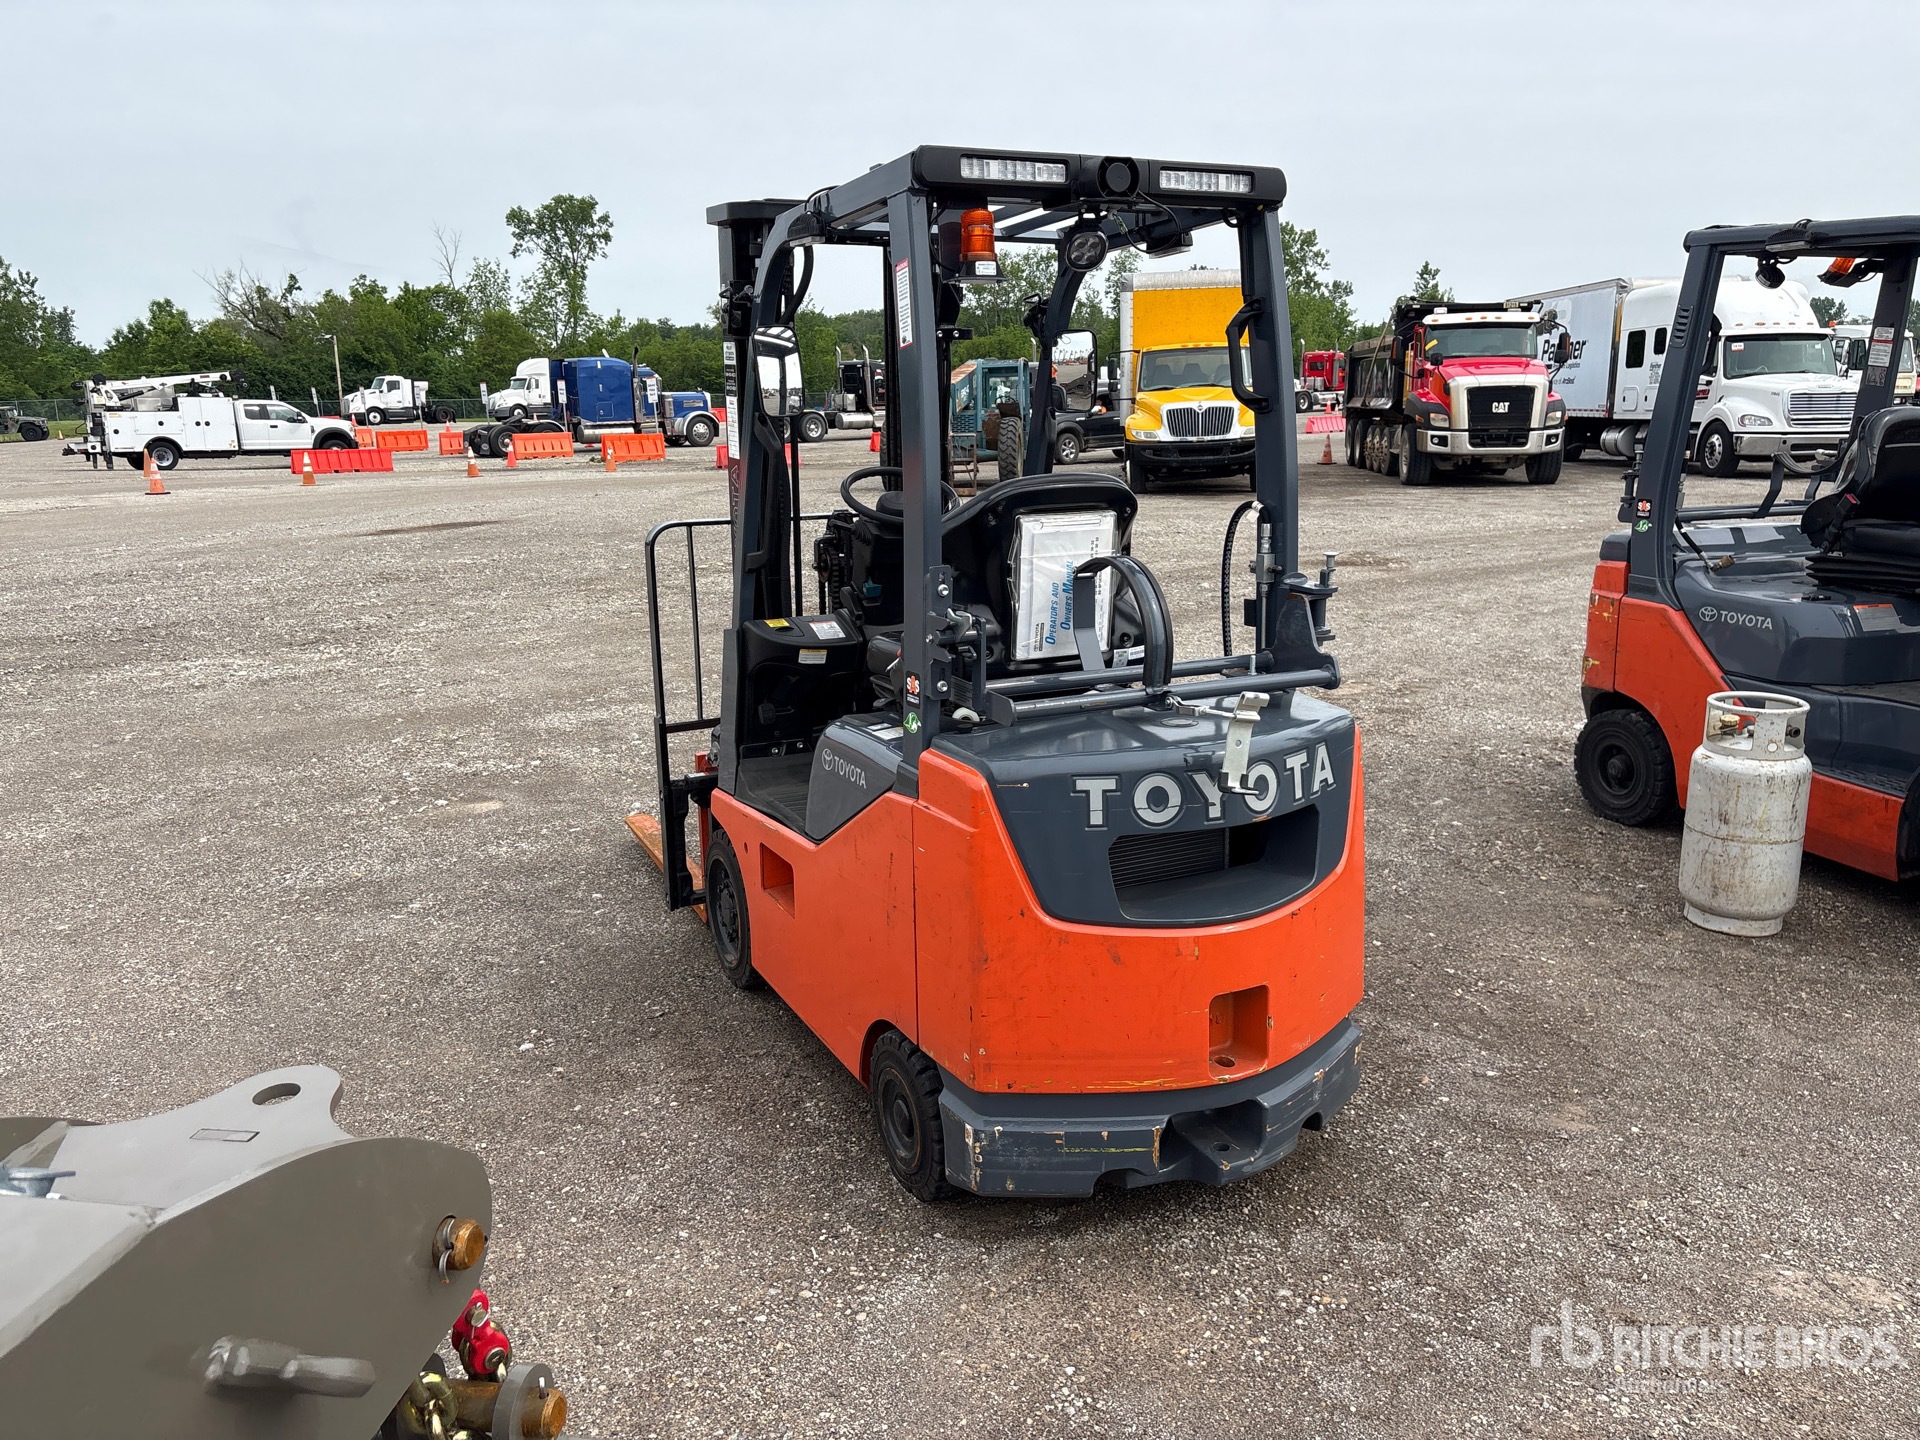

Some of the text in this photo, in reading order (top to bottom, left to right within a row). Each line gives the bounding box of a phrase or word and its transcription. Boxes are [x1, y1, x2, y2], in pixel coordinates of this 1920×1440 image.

[1492, 401, 1510, 413] CAT
[1720, 610, 1773, 630] TOYOTA
[834, 755, 867, 789] TOYOTA
[1073, 742, 1335, 829] TOYOTA
